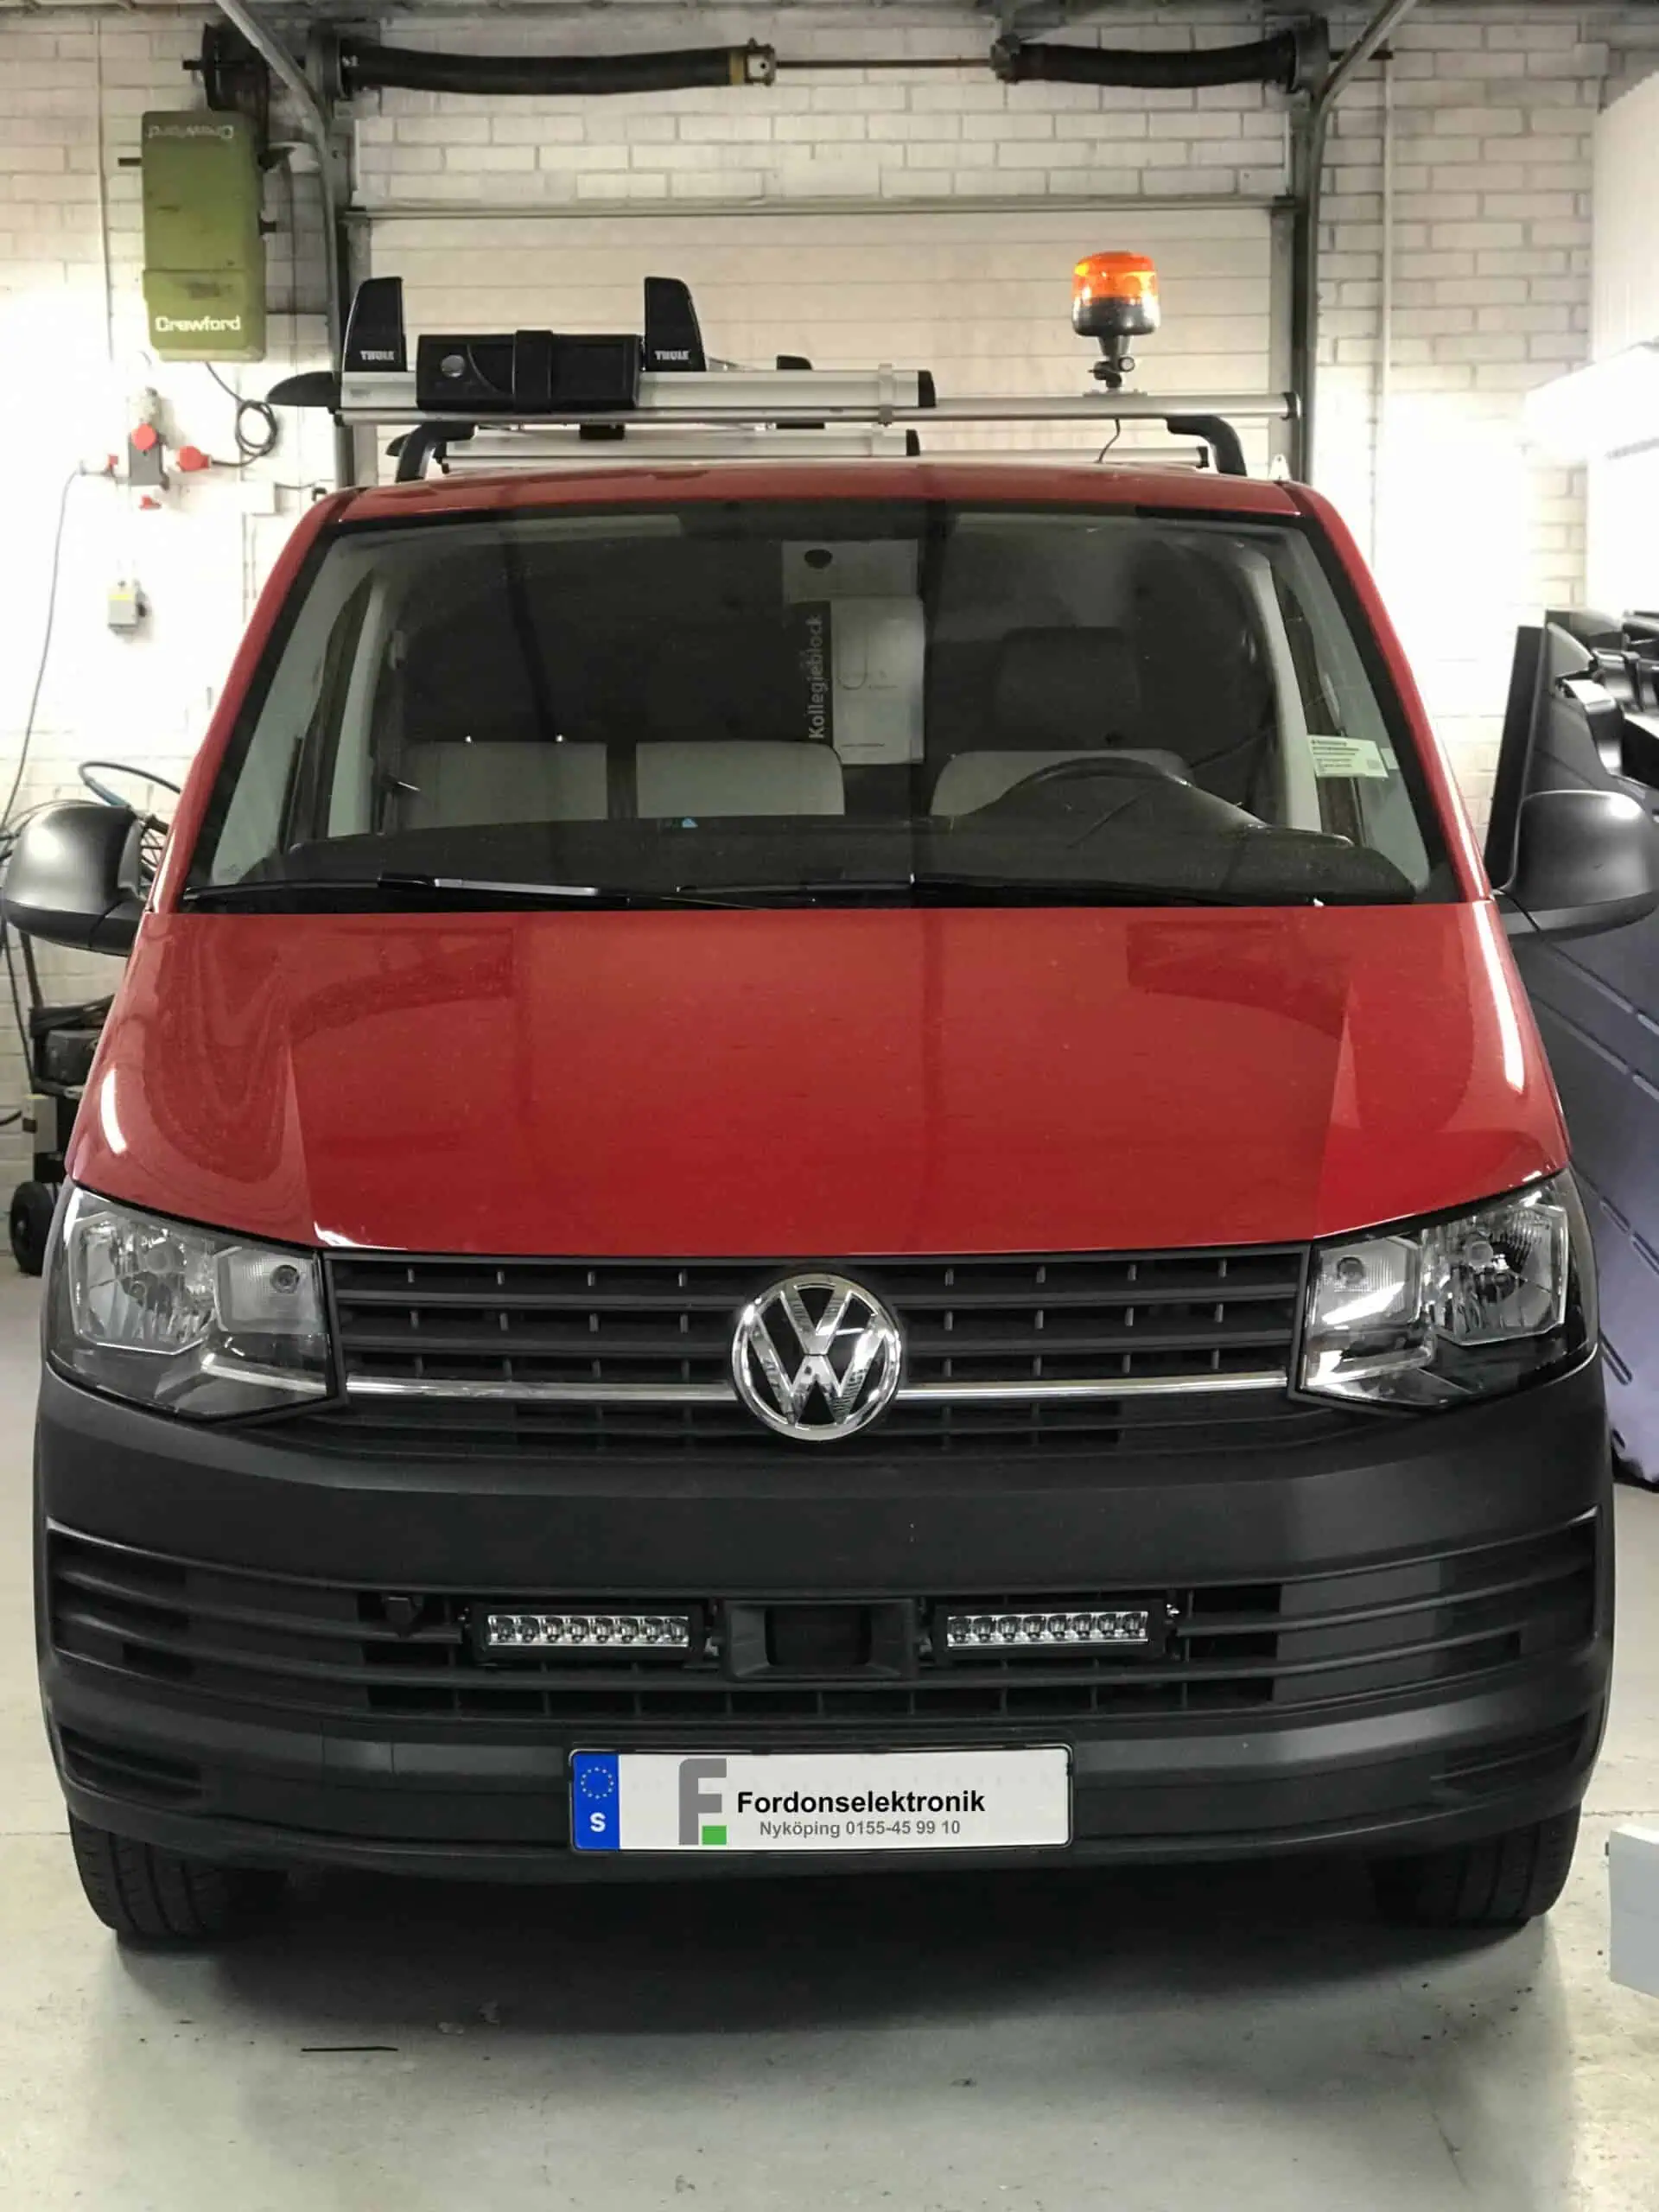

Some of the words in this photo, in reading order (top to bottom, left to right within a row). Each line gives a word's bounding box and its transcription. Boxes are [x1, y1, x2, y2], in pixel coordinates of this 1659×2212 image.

[156, 315, 241, 332] Crawford
[359, 350, 395, 360] THULE
[654, 350, 690, 361] THULE
[805, 614, 829, 740] Kollegieblock
[737, 1790, 986, 1814] Fordonselektronik
[589, 1812, 607, 1833] S
[760, 1821, 841, 1839] Nyköping
[845, 1821, 912, 1835] 0155-45
[916, 1821, 936, 1834] 99
[942, 1820, 961, 1834] 10
